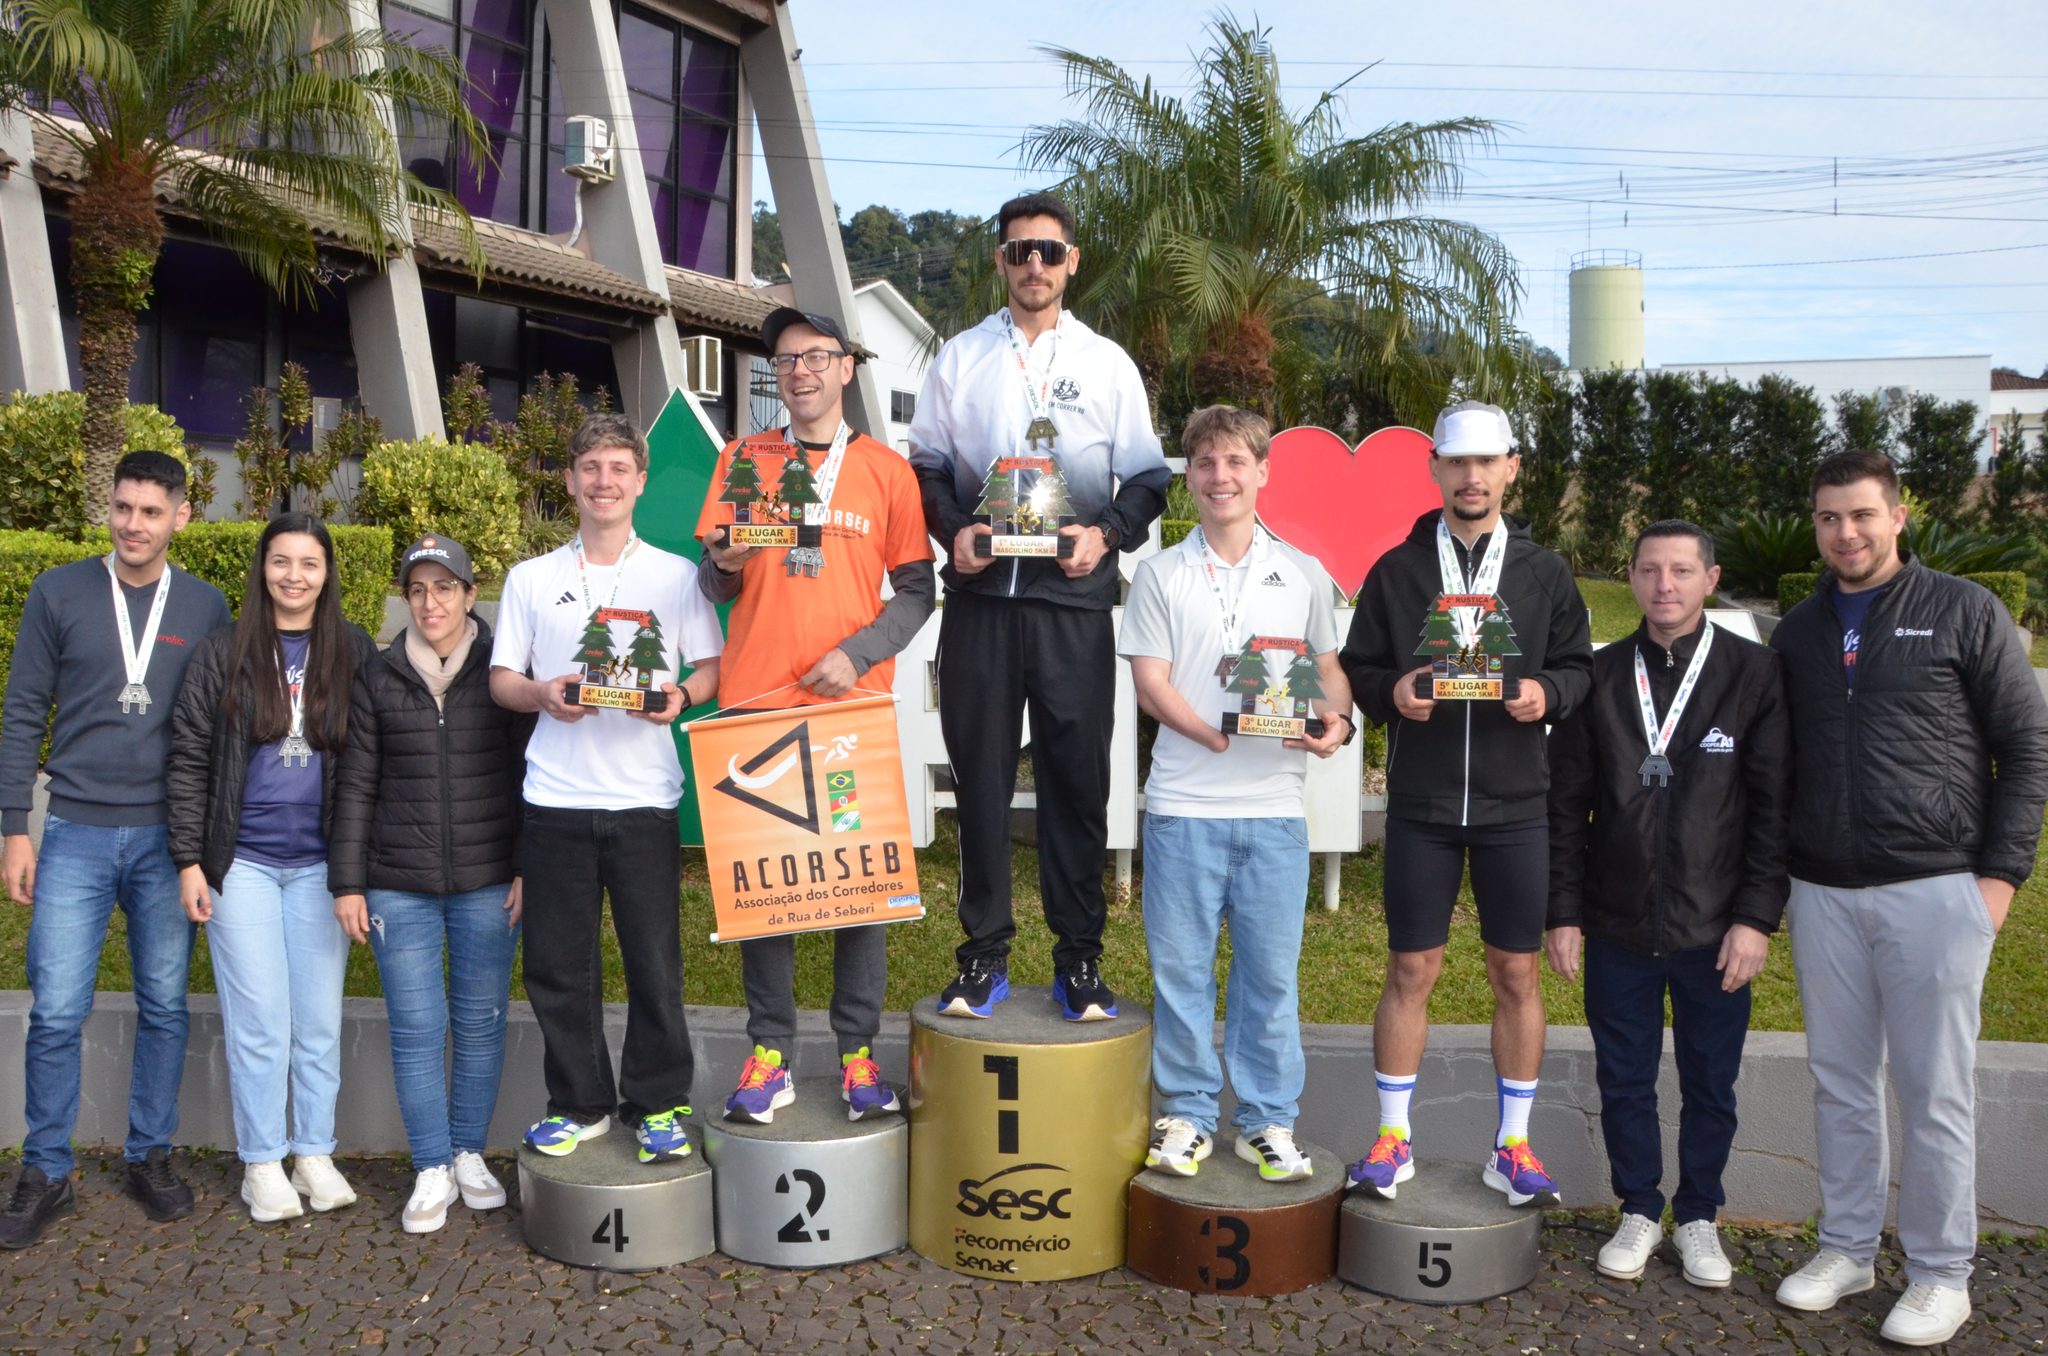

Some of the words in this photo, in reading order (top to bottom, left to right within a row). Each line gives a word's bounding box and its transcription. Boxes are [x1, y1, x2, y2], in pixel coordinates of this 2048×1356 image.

[736, 528, 746, 537] 2º
[749, 528, 784, 537] LUGAR
[409, 549, 450, 561] CRESOL
[1905, 628, 1934, 637] Sicredi
[598, 689, 631, 700] LUGAR
[1440, 682, 1450, 690] 5º
[1453, 682, 1488, 690] LUGAR
[583, 697, 620, 706] MASCULINO
[621, 700, 635, 708] 5KM
[1241, 727, 1280, 735] MASCULINO
[1245, 718, 1254, 726] 3º
[1257, 718, 1292, 729] LUGAR
[733, 841, 901, 893] ACORSEB
[735, 892, 802, 910] Associação
[806, 885, 829, 902] dos
[832, 880, 904, 898] Corredores
[768, 914, 784, 926] de
[788, 911, 811, 924] Rua
[815, 906, 831, 920] de
[834, 902, 875, 918] Seberi
[983, 1055, 1019, 1155] 1
[775, 1169, 830, 1243] 2
[956, 1178, 1072, 1222] Sesc
[592, 1208, 630, 1253] 4
[956, 1251, 1016, 1274] Senac
[1199, 1215, 1251, 1290] 3
[1417, 1242, 1453, 1288] 5
